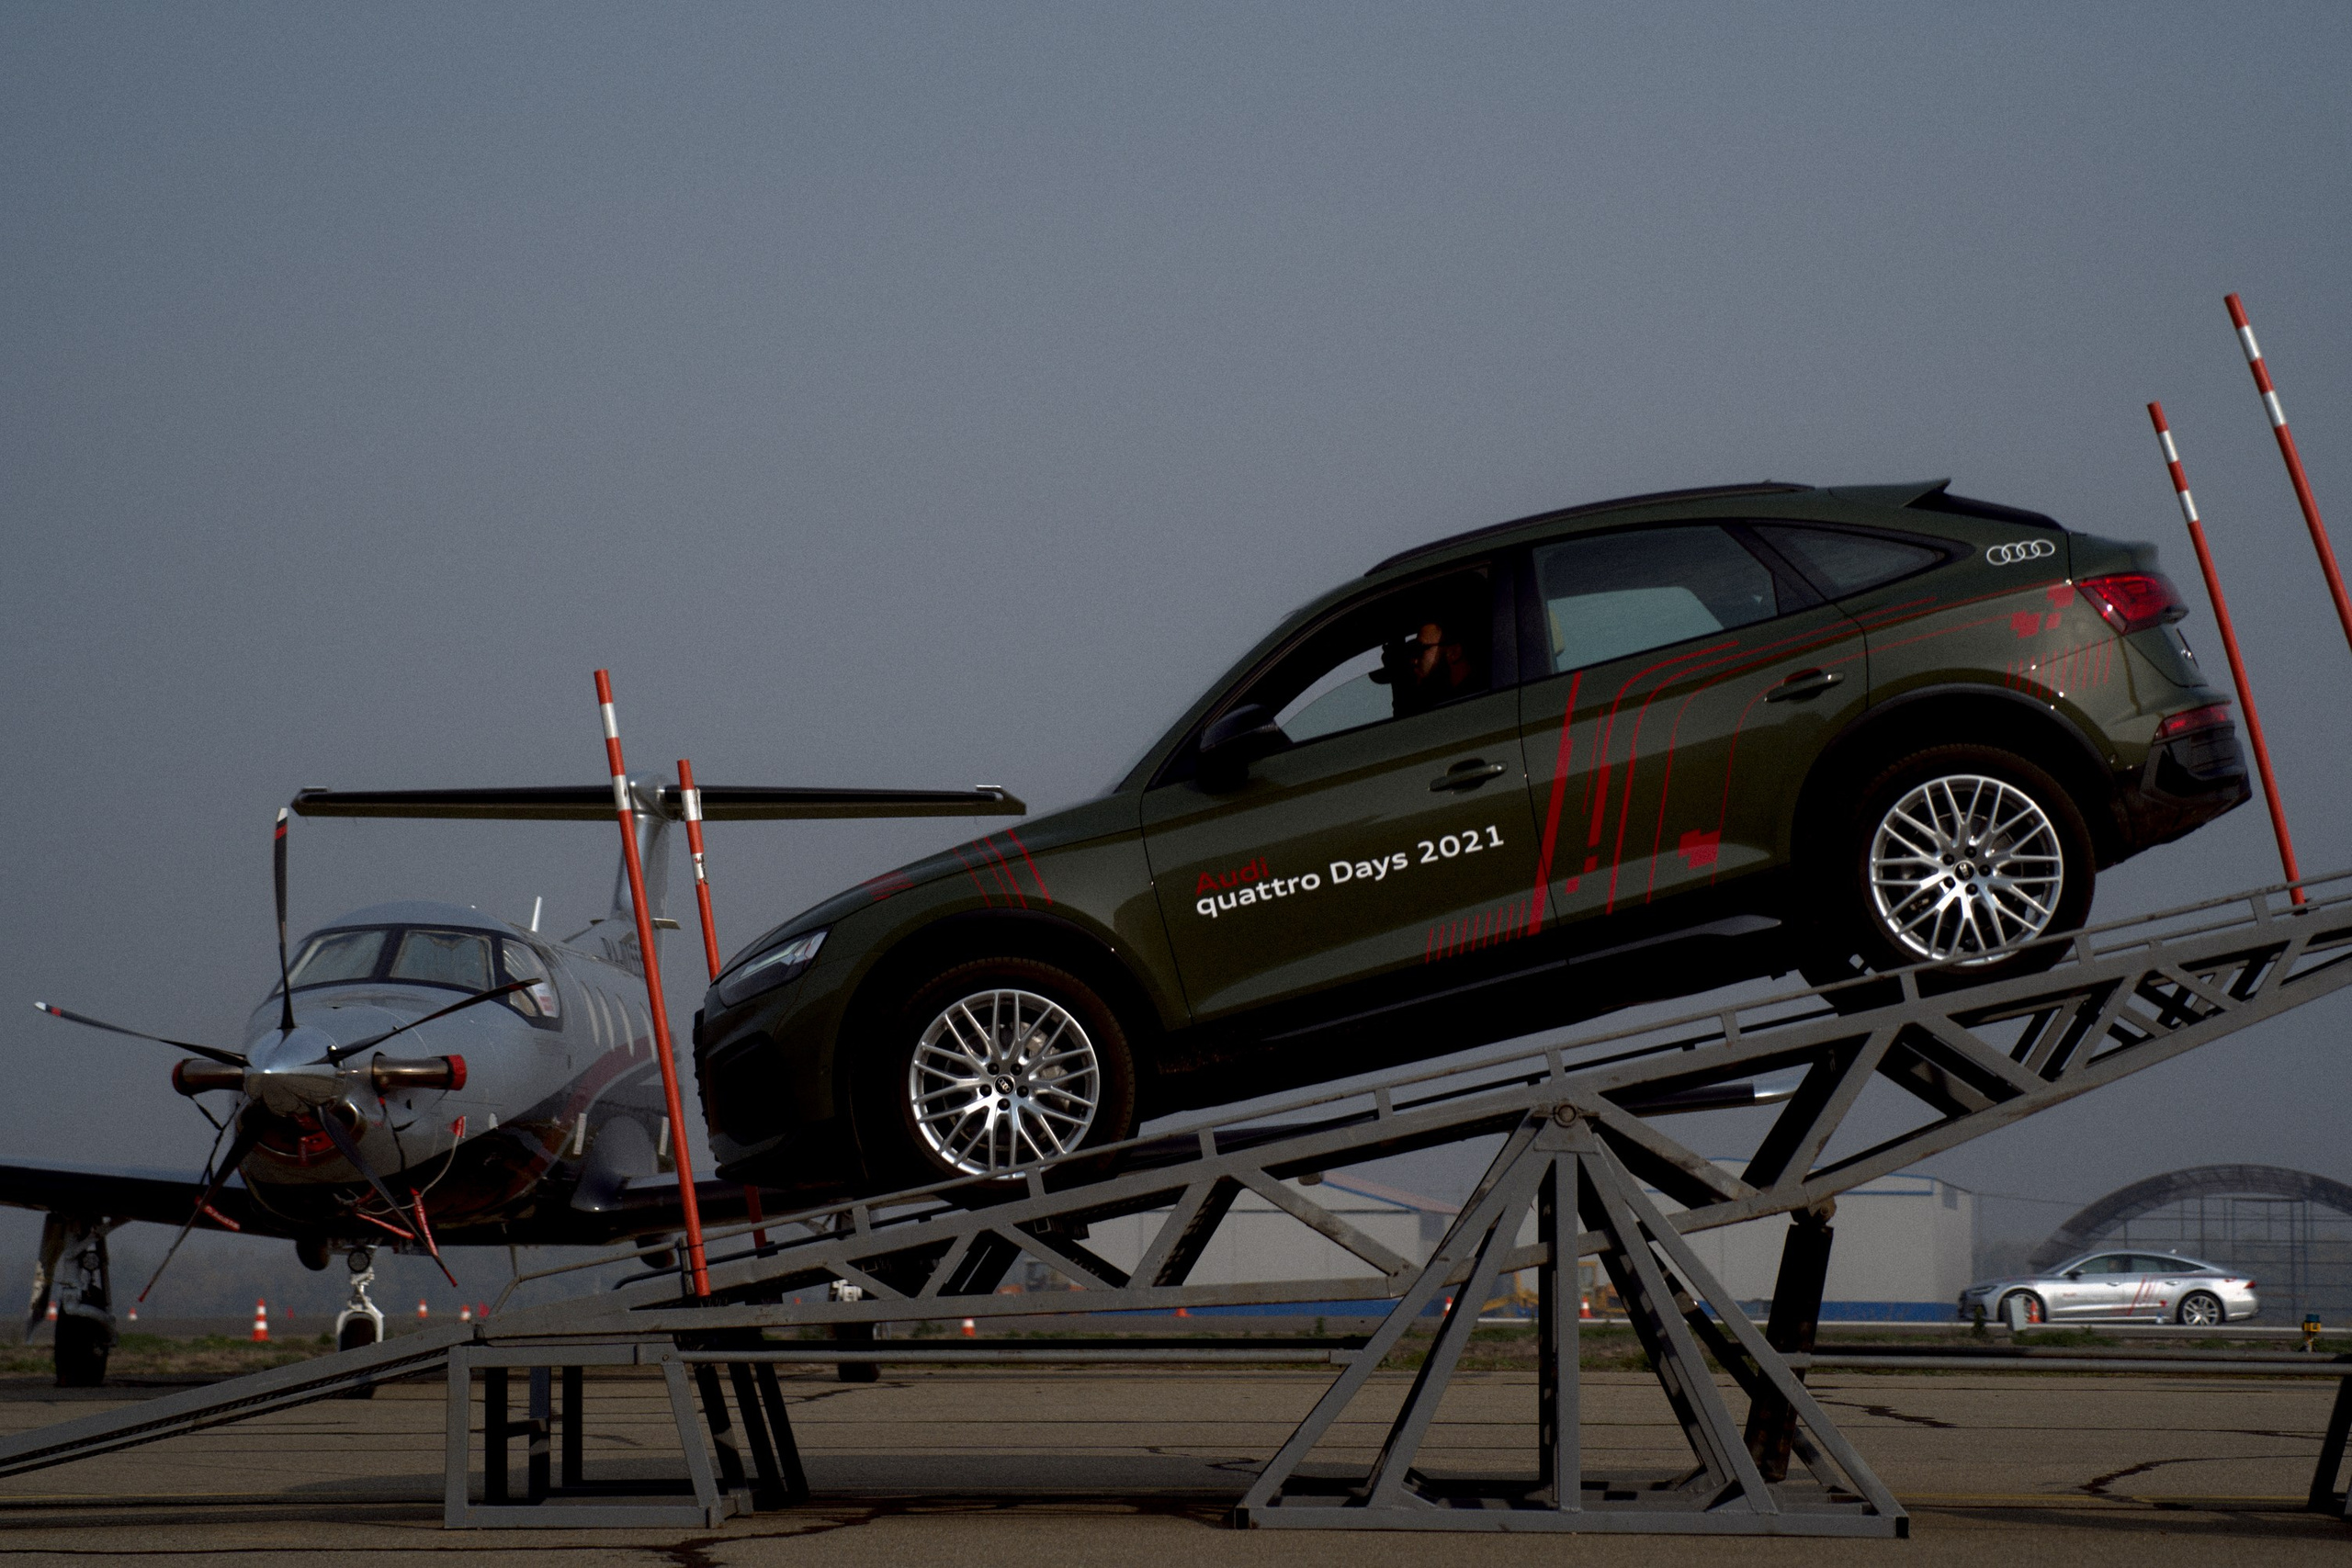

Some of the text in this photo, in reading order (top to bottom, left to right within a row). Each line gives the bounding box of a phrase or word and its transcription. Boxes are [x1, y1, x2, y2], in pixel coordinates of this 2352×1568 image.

[1195, 856, 1270, 897] Audi
[1196, 825, 1505, 919] quattro Days 2021
